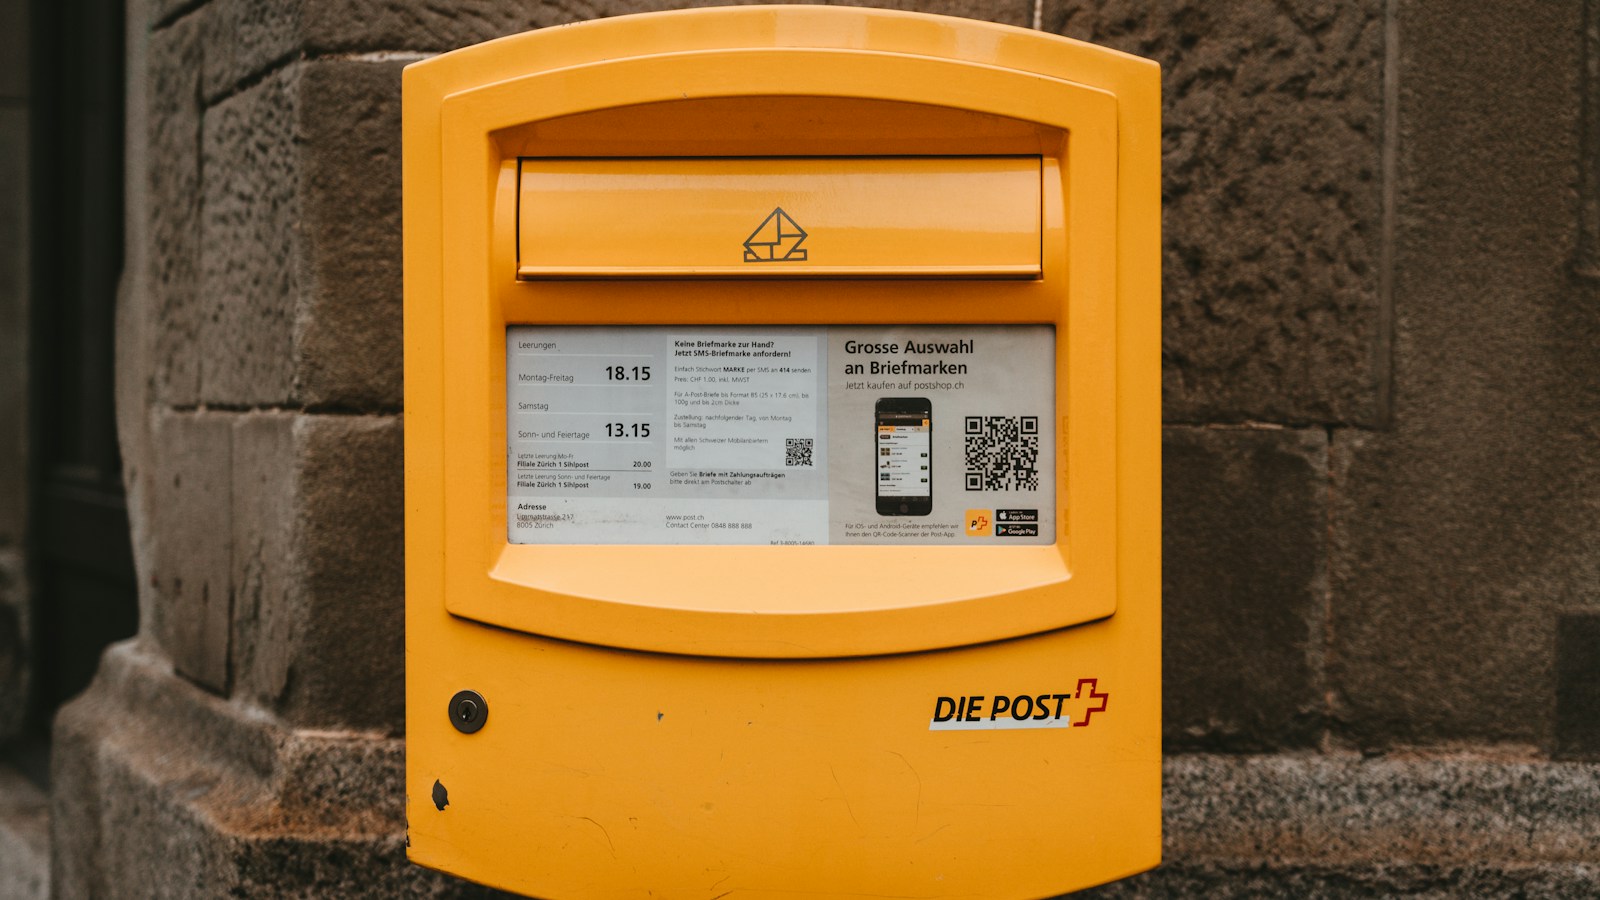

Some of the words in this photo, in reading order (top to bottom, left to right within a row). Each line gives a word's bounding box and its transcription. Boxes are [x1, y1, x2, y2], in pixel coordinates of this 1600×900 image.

[518, 341, 556, 350] Leerungen
[845, 340, 899, 354] Grosse
[904, 340, 974, 354] Auswahl
[845, 364, 864, 374] an
[870, 360, 968, 374] Briefmarken
[518, 374, 574, 383] Montag-Freitag
[606, 366, 650, 380] 18.15
[846, 381, 864, 390] Jetzt
[867, 381, 896, 390] kaufen
[898, 381, 912, 390] auf
[914, 381, 964, 391] postshop.ch
[518, 402, 548, 412] Samstag
[558, 431, 590, 440] Feiertage
[605, 423, 650, 438] 13.15
[933, 696, 984, 722] DIE
[990, 694, 1070, 721] POST
